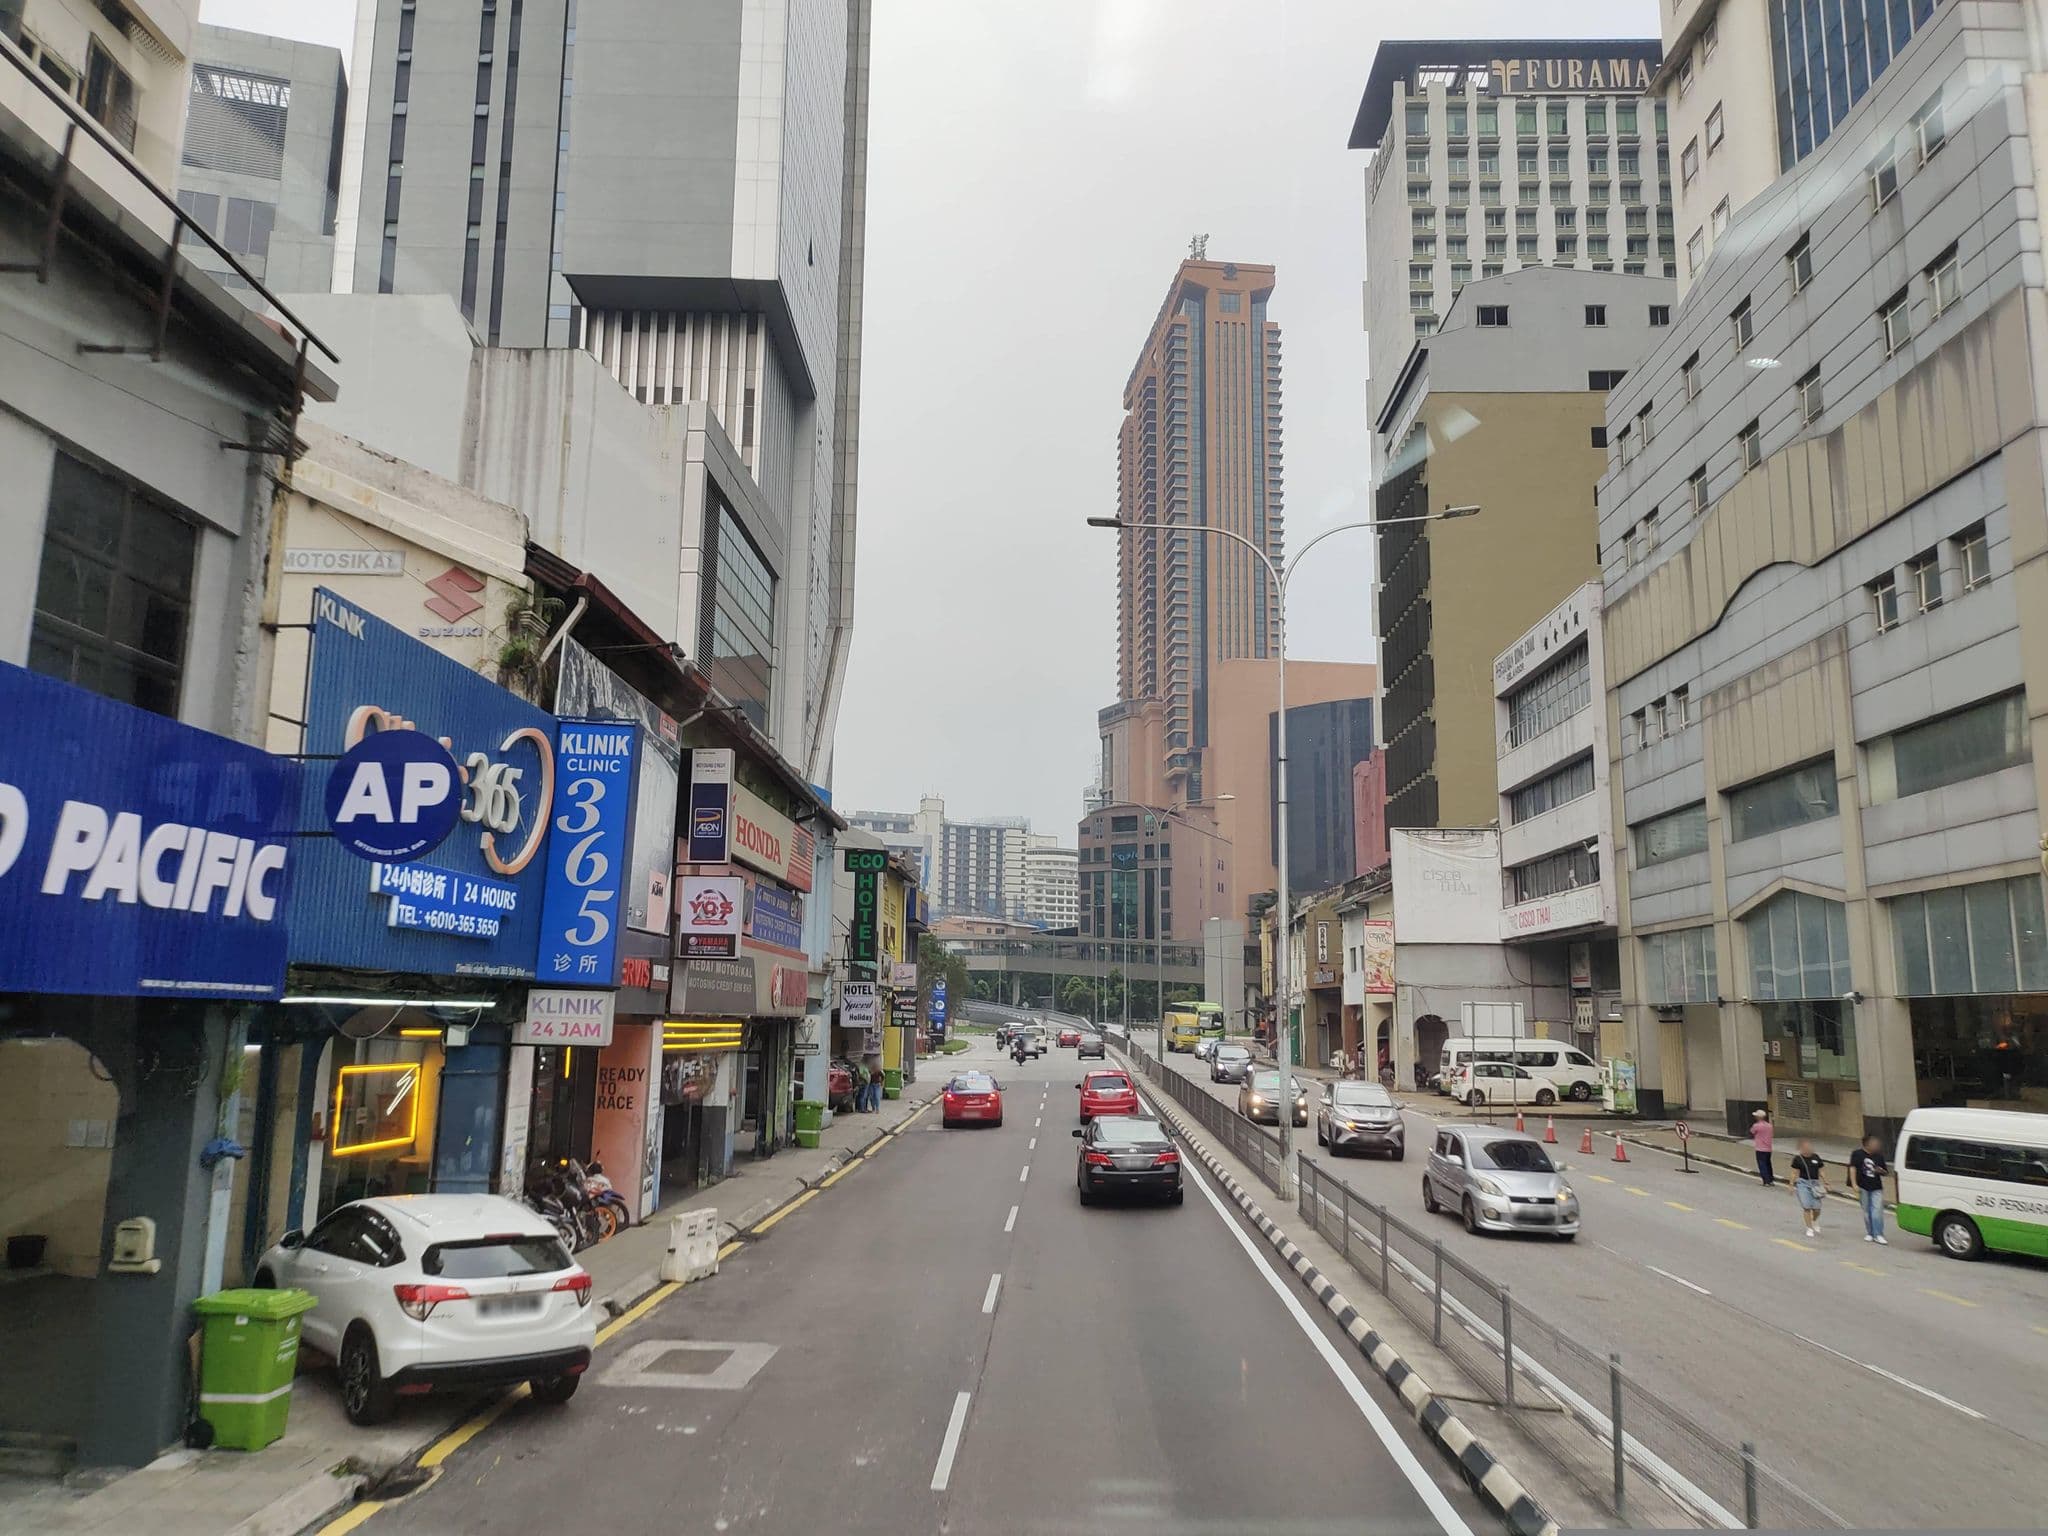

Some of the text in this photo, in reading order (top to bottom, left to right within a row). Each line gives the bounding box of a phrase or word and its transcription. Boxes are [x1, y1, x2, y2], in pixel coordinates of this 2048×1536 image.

[1526, 59, 1650, 89] FURAMA
[284, 551, 398, 569] MOTOSIKAL
[419, 627, 483, 638] SUZUKI
[560, 733, 630, 757] KLINIK
[567, 758, 621, 773] CLINIC
[335, 762, 450, 823] AP
[460, 752, 523, 833] 365
[735, 814, 782, 865] HONDA
[41, 800, 287, 921] PACIFIC
[848, 854, 884, 869] ECO
[463, 882, 478, 903] 24
[481, 885, 517, 911] HOURS
[399, 904, 423, 925] TEL:
[476, 918, 499, 937] 3650
[858, 873, 873, 957] HOTEL
[1519, 909, 1535, 928] CISCO
[1536, 905, 1551, 925] THAI
[699, 937, 728, 946] YAMAHA
[553, 953, 599, 975] 诊所
[689, 959, 753, 978] KEDAI MOTOSIKAL
[844, 985, 873, 995] HOTEL
[531, 996, 604, 1016] KLINIK
[849, 1014, 873, 1024] Holiday
[531, 1021, 602, 1038] 24 JAM
[599, 1067, 646, 1082] READY
[600, 1081, 616, 1096] TO
[597, 1096, 634, 1110] RACE
[1976, 1195, 1996, 1208] BAS
